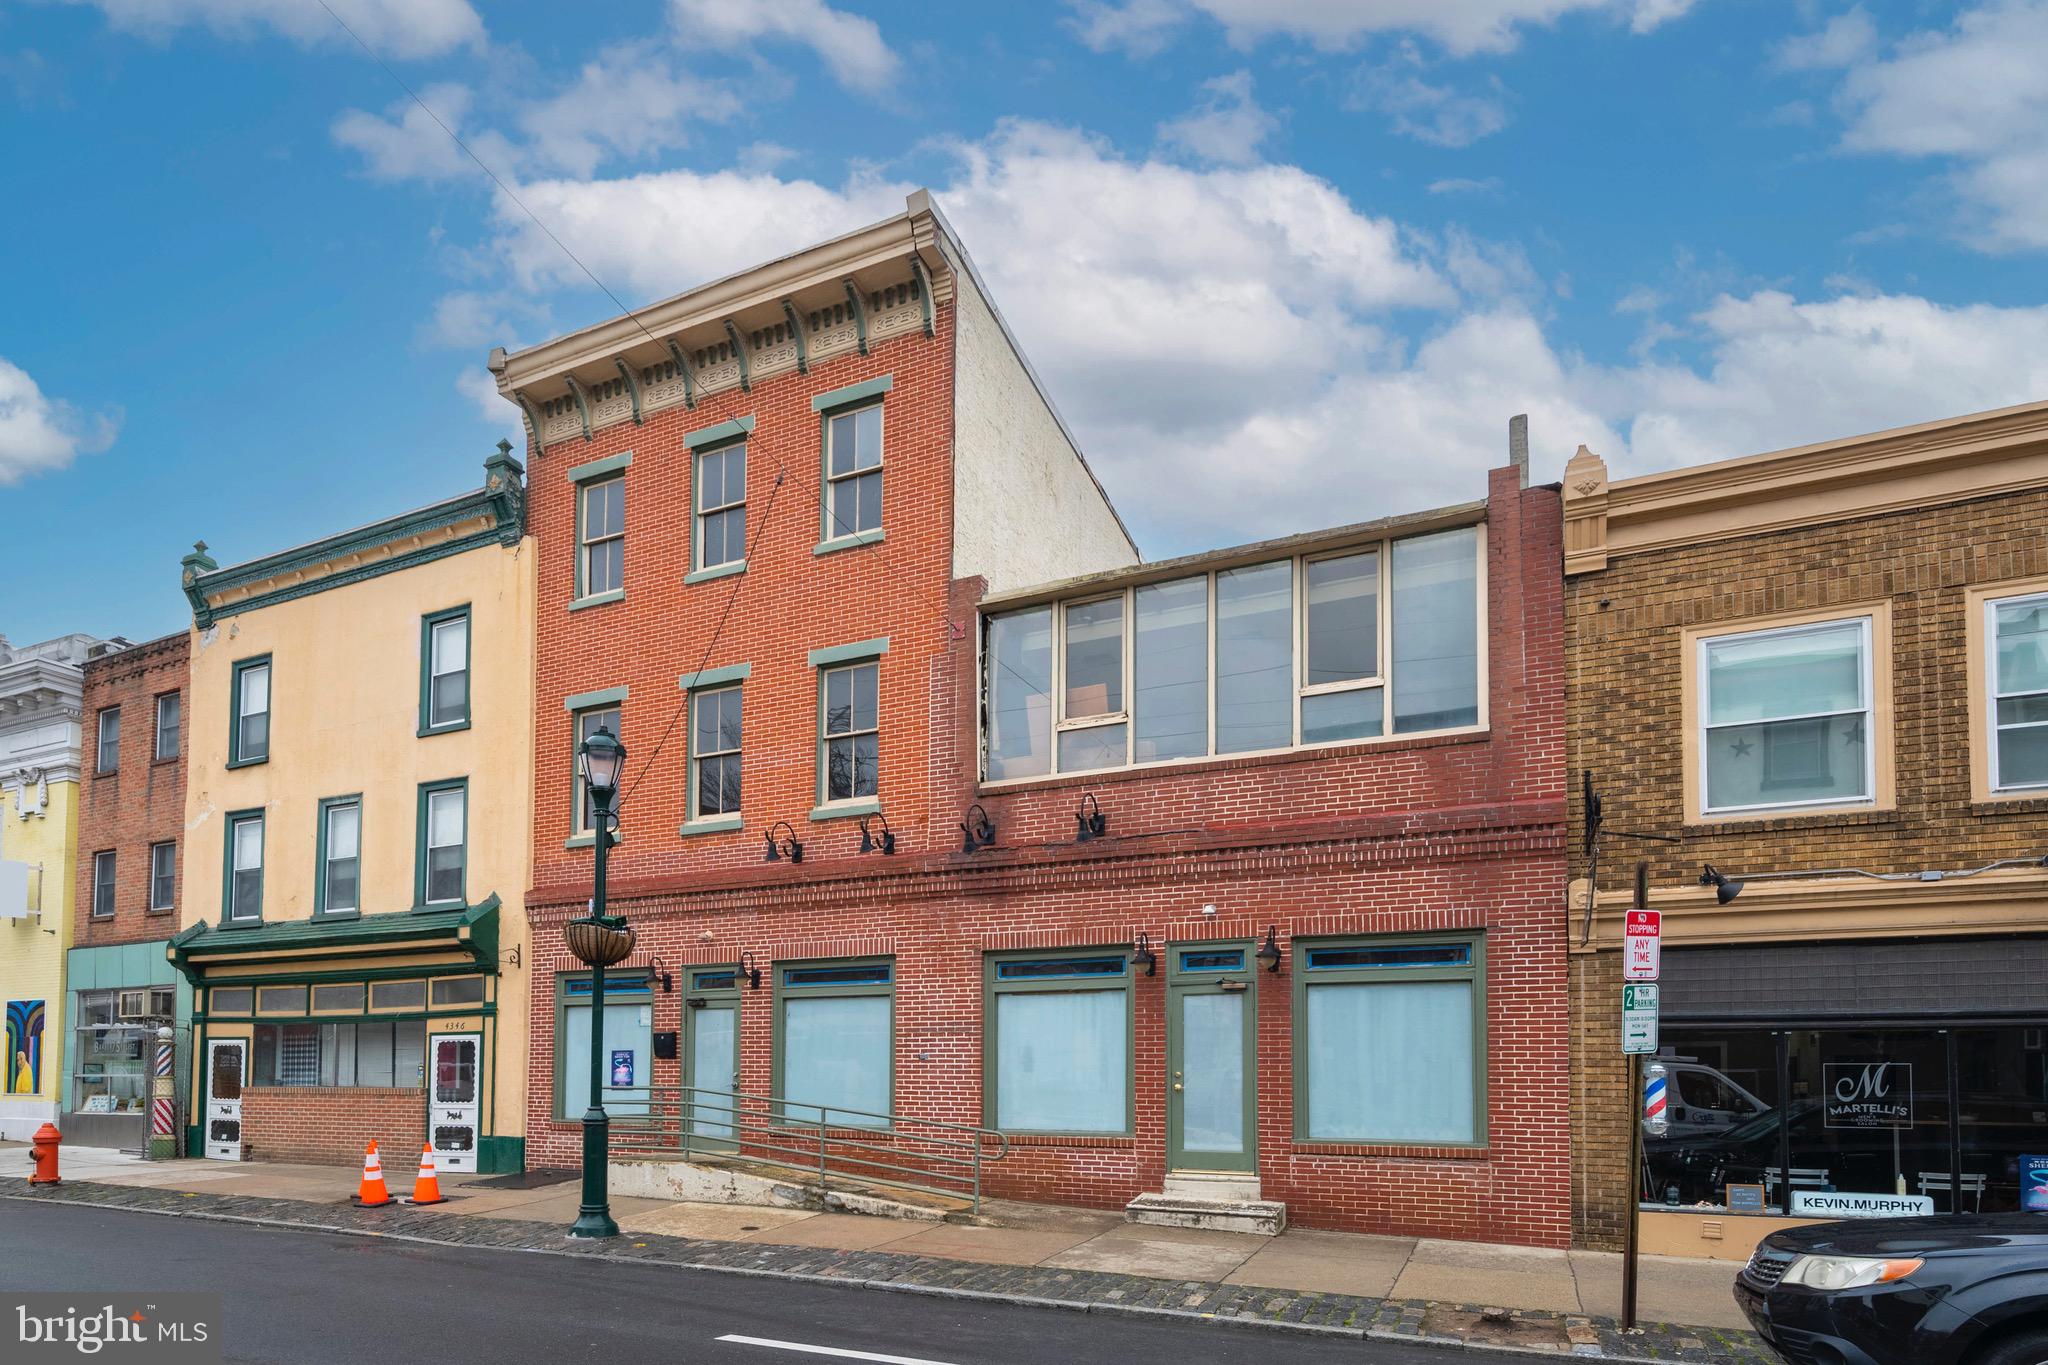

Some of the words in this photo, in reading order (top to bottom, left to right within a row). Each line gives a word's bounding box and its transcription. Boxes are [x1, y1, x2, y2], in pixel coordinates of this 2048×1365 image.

[1637, 913, 1647, 923] NO
[1628, 925, 1657, 934] STOPPING
[1634, 939, 1650, 950] ANY
[1633, 951, 1650, 963] TIME
[1626, 989, 1633, 1007] 2
[1640, 988, 1650, 998] HR
[1634, 999, 1656, 1008] PARKING
[445, 1022, 465, 1030] 4346
[1835, 1061, 1891, 1102] M
[1829, 1103, 1908, 1116] MARTELLI'S
[1803, 1197, 1924, 1212] KEVIN.MURPHY
